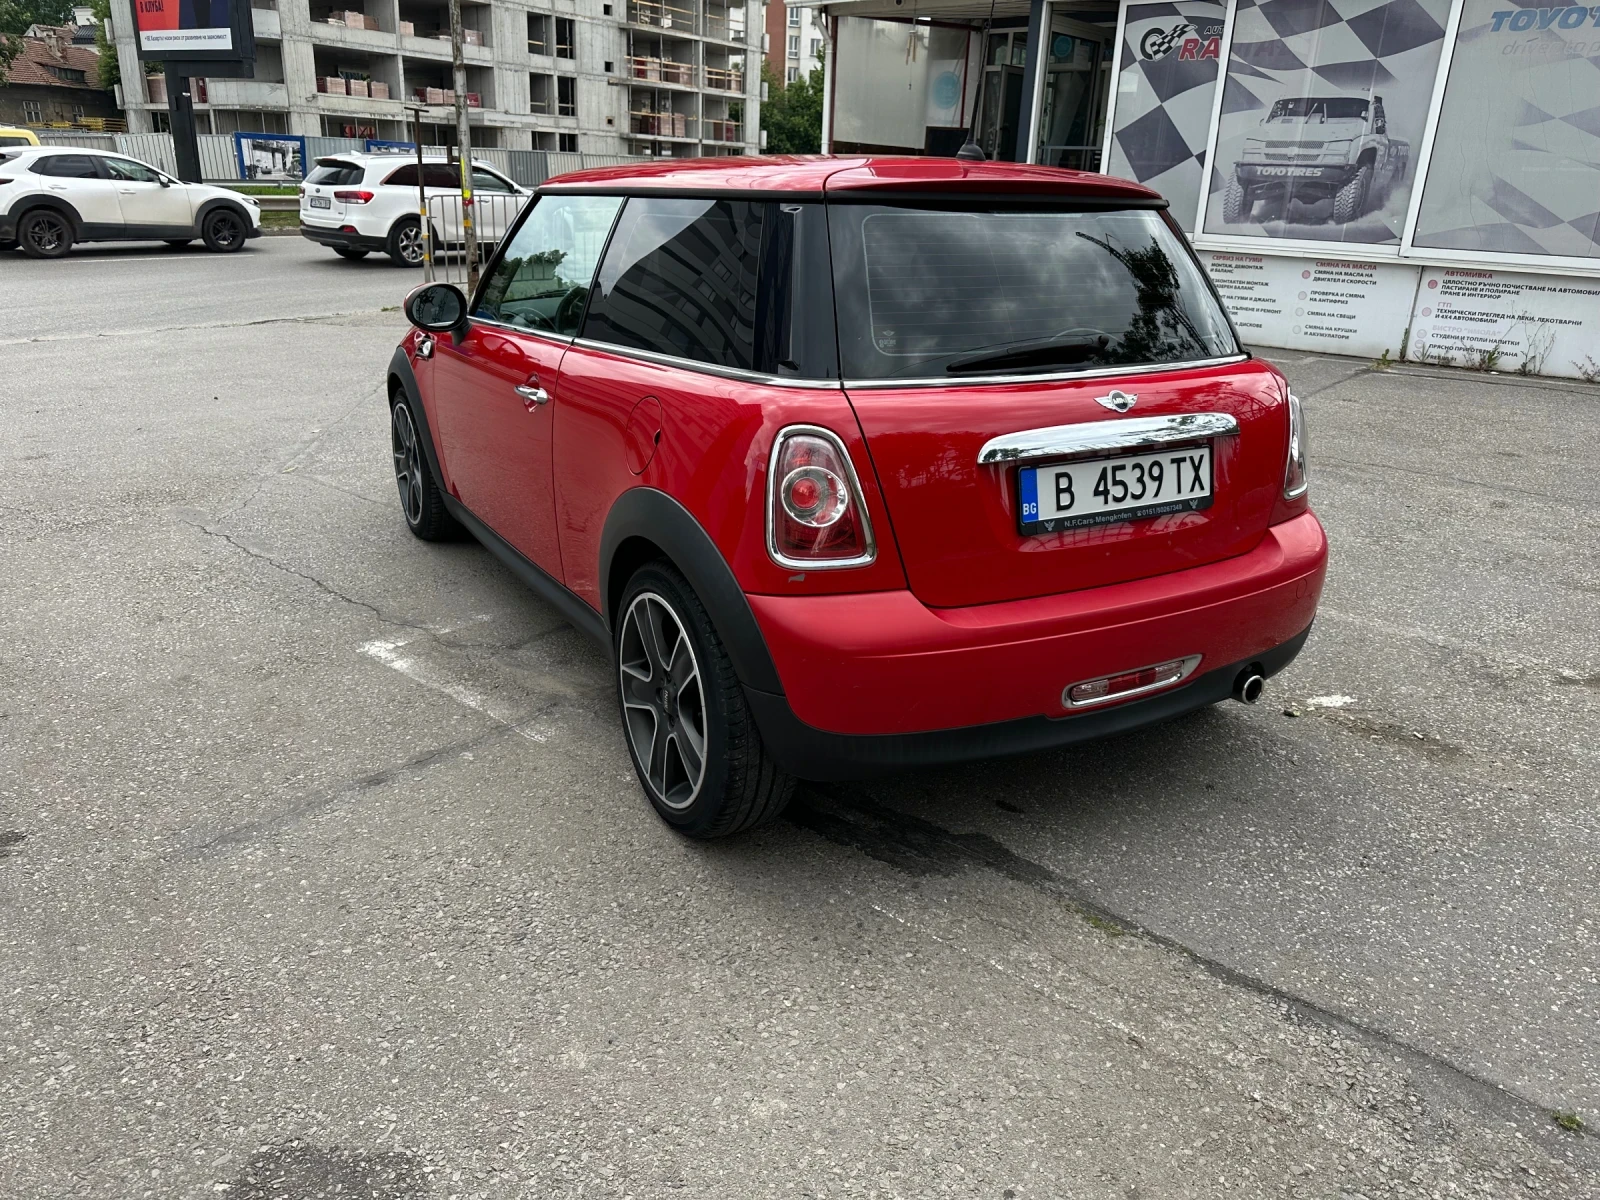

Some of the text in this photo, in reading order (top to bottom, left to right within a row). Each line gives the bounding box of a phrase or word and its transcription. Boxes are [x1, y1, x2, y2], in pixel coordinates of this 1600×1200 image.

[1352, 263, 1377, 271] МАСЛА
[1444, 270, 1493, 279] АВТОМИВКА
[1442, 279, 1478, 287] ЦЯЛОСТНО
[1501, 283, 1546, 292] ПОЧИСТВАНЕ
[1485, 288, 1520, 296] ПОЛИРАНЕ
[1436, 308, 1477, 316] ТЕХНИЧЕСКИ
[1477, 311, 1505, 319] ПРЕГЛЕД
[1536, 316, 1582, 326] ЛЕКОТВАРНИ
[1453, 315, 1498, 324] АВТОМОБИЛИ
[1432, 325, 1462, 333] БИСТРО
[1308, 332, 1350, 340] АКУМУЛАТОРИ
[1431, 333, 1460, 341] СТУДЕНИ
[1488, 338, 1520, 346] НАПИТКИ
[1429, 343, 1454, 351] ПРЯСНО
[1497, 350, 1518, 358] ХРАНА
[1054, 453, 1205, 512] B 4539 TX
[1022, 502, 1037, 515] BG
